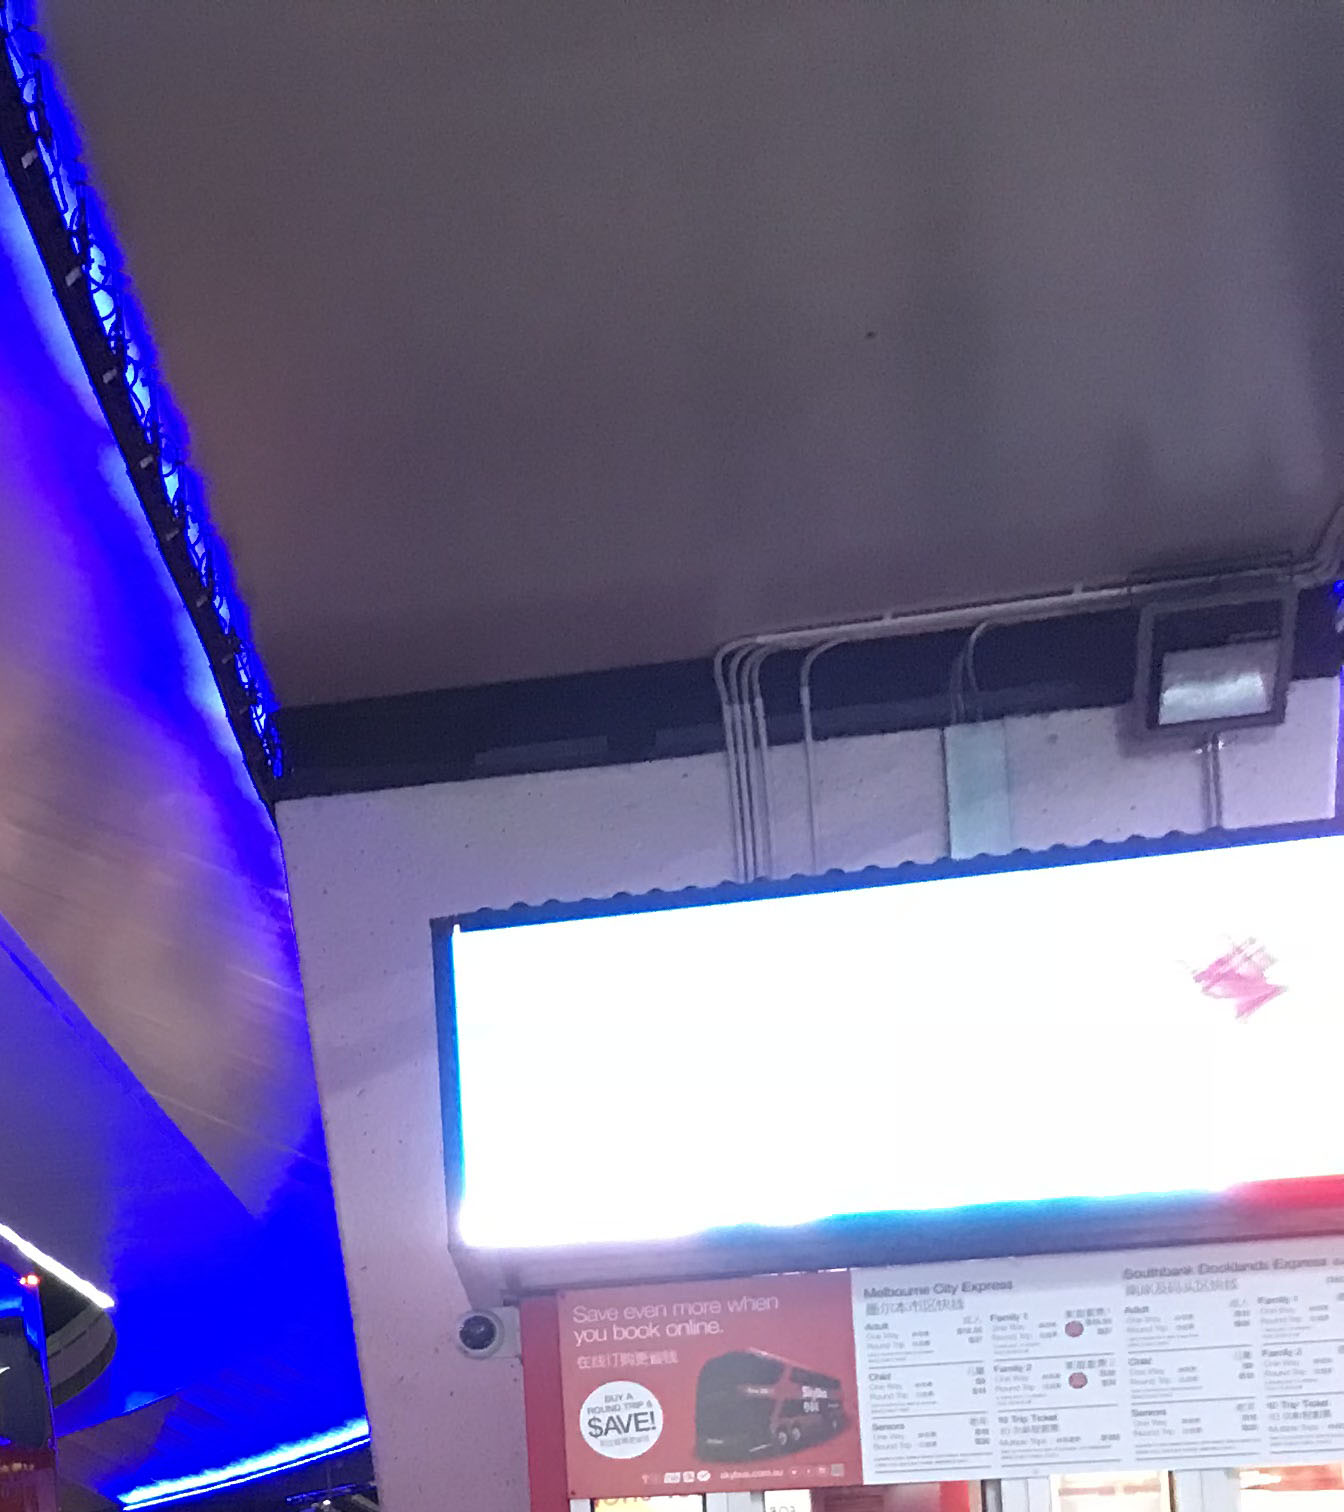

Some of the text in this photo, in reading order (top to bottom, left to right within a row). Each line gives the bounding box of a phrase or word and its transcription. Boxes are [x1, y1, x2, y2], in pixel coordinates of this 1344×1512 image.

[933, 1282, 958, 1295] City
[572, 1296, 778, 1323] Save even more when
[574, 1318, 724, 1346] you book online.
[588, 1411, 656, 1438] $AVE!
